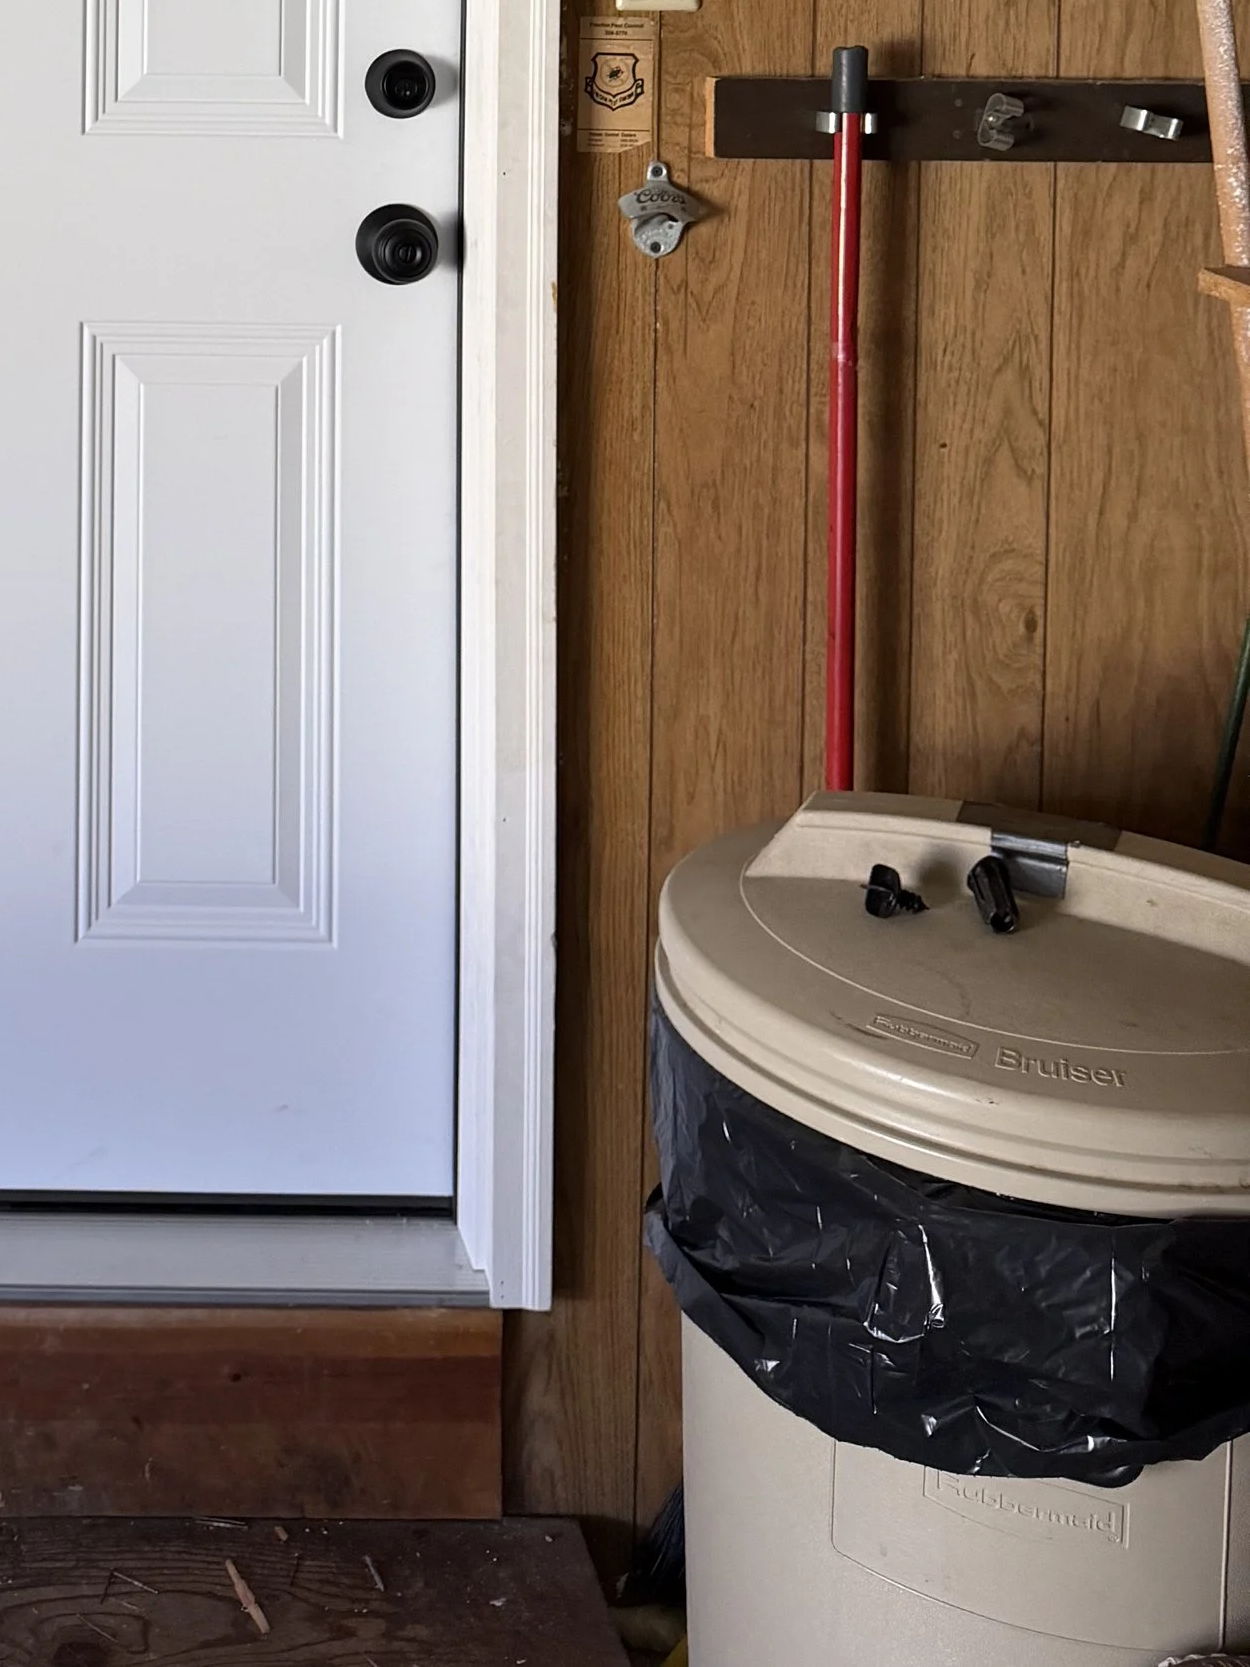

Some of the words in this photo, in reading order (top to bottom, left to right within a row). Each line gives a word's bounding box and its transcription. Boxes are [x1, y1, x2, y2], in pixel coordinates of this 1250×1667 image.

[636, 188, 687, 205] Coors
[995, 1046, 1126, 1087] Bruiser
[936, 1469, 1116, 1534] Rubbermaid
